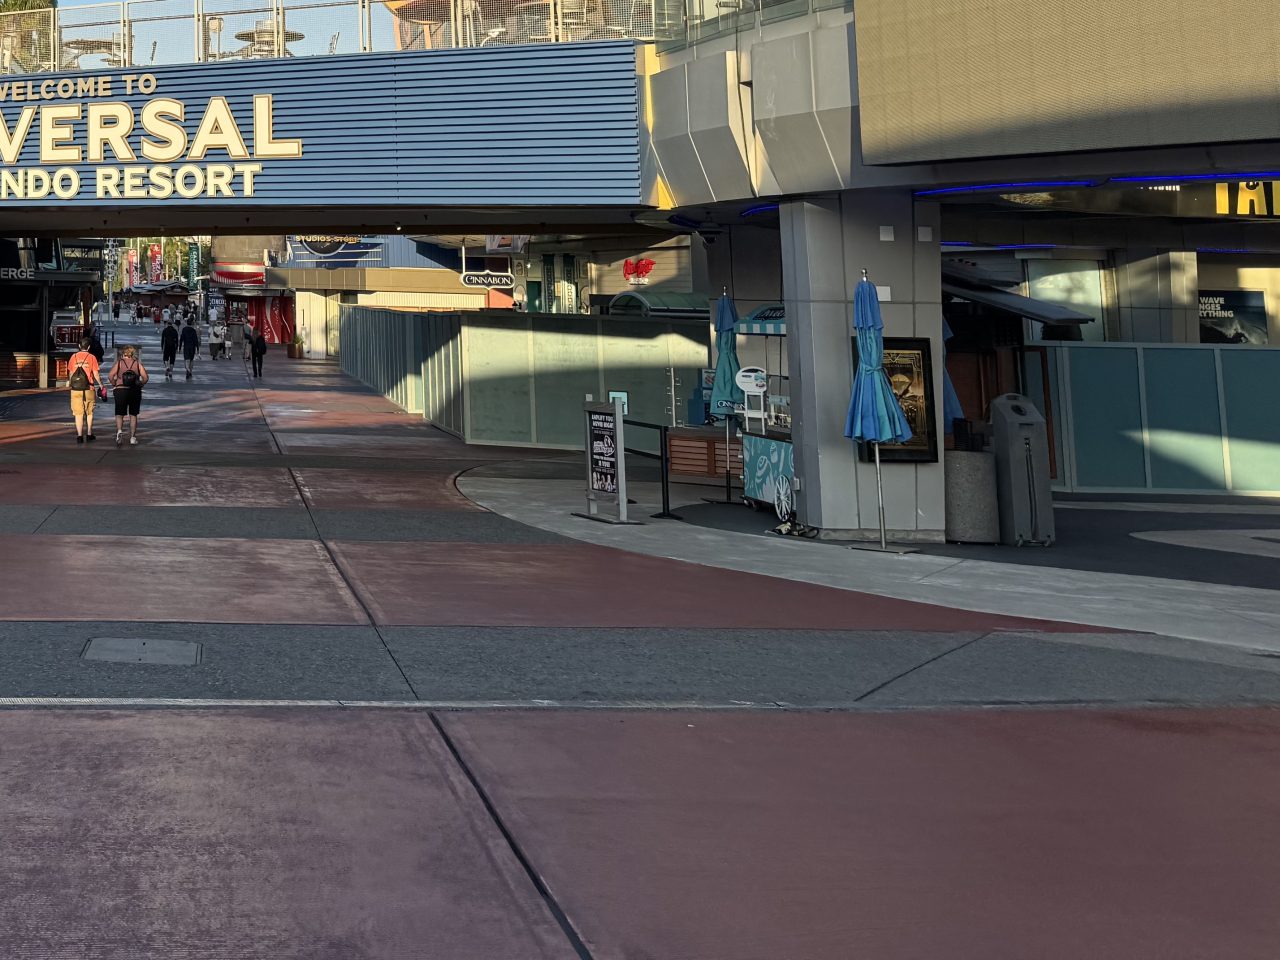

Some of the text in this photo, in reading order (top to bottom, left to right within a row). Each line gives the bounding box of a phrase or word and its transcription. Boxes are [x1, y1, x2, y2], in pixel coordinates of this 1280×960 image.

[122, 73, 158, 95] TO
[95, 163, 262, 199] RESORT
[465, 275, 512, 285] CINNABON
